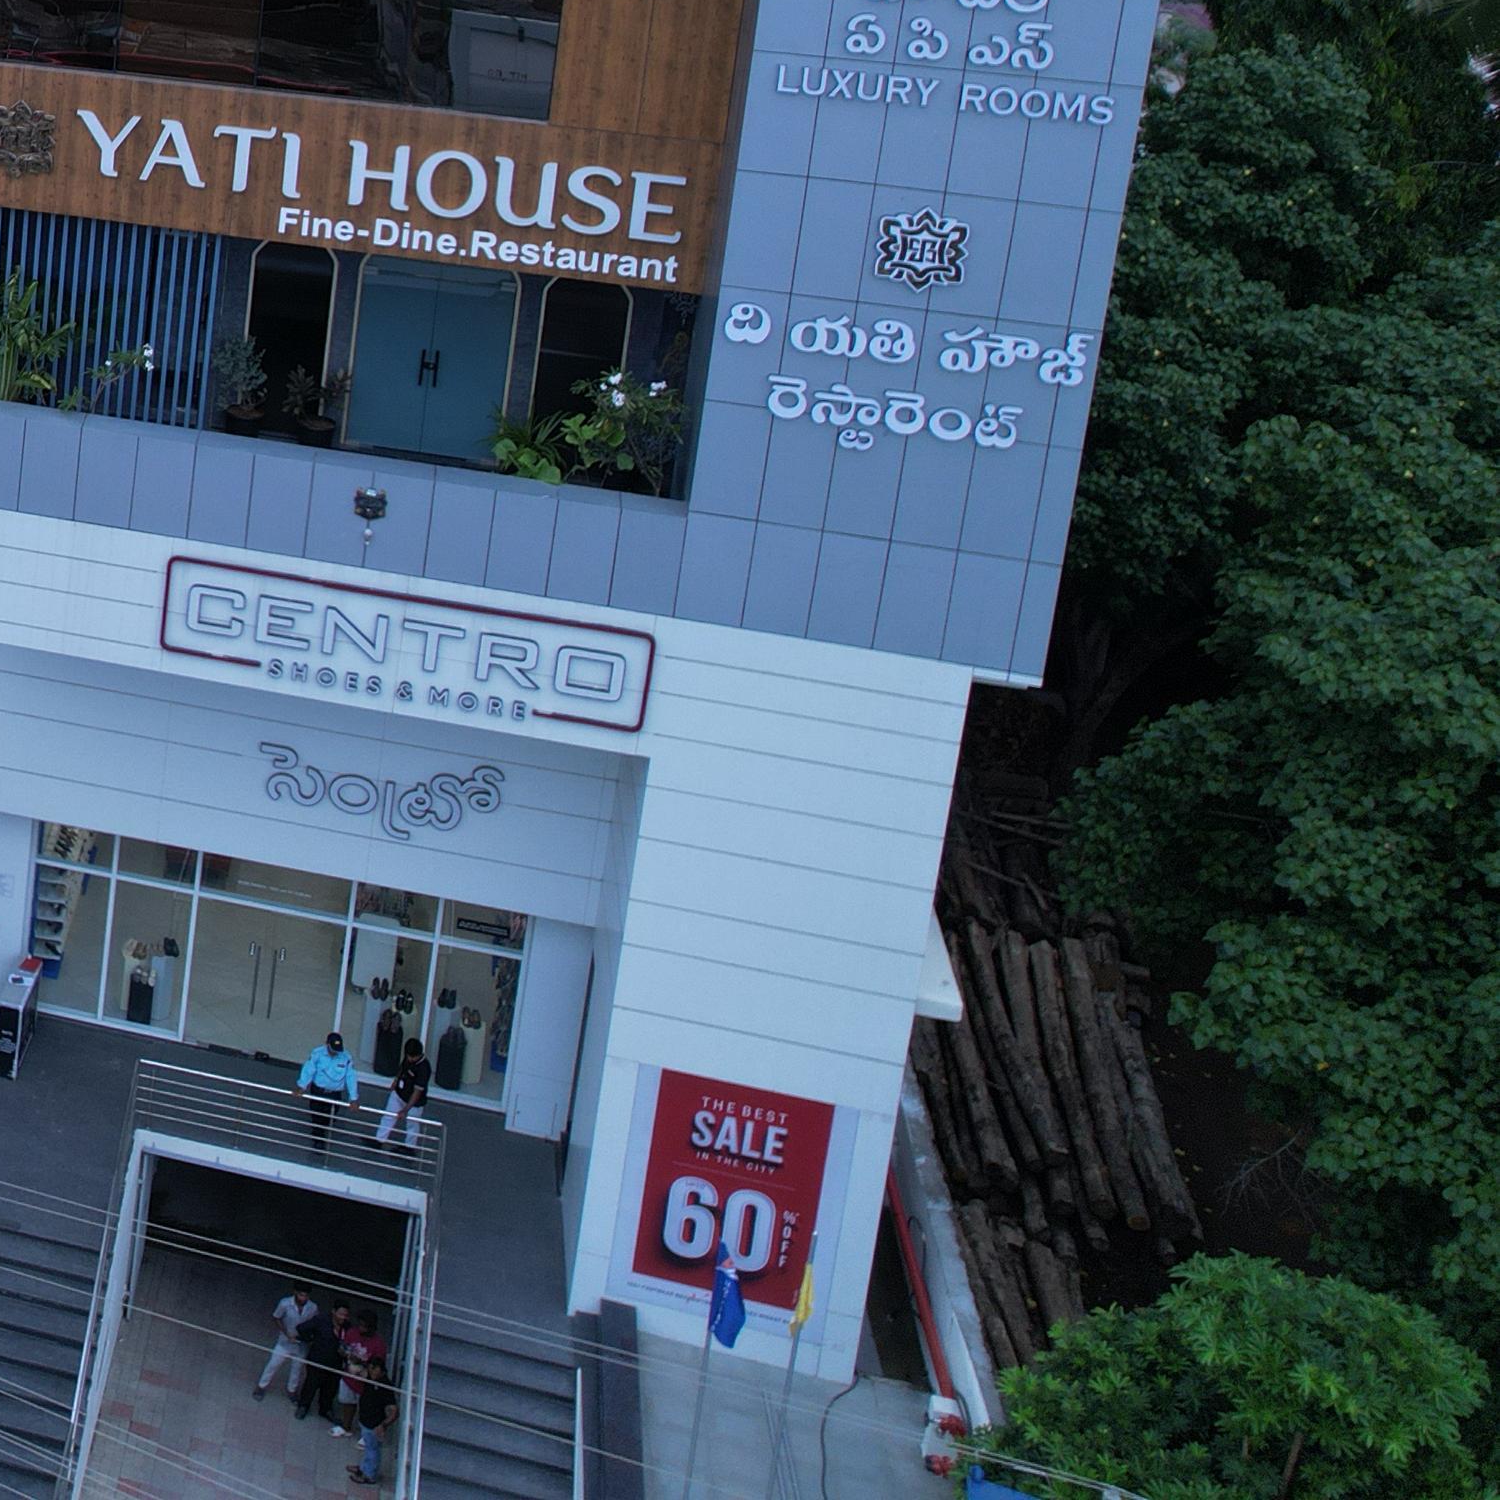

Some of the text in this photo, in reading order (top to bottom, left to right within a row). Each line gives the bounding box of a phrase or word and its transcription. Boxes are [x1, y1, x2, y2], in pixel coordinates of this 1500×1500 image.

[776, 65, 1116, 126] LUXURY ROOMS
[77, 109, 688, 244] YATI HOUSE
[186, 584, 626, 702] CENTRO
[267, 659, 526, 721] SHOES & MORE
[691, 1110, 788, 1163] SALE
[702, 1097, 788, 1124] THE BEST
[696, 1151, 775, 1175] IN THE CITY
[662, 1175, 777, 1272] 60
